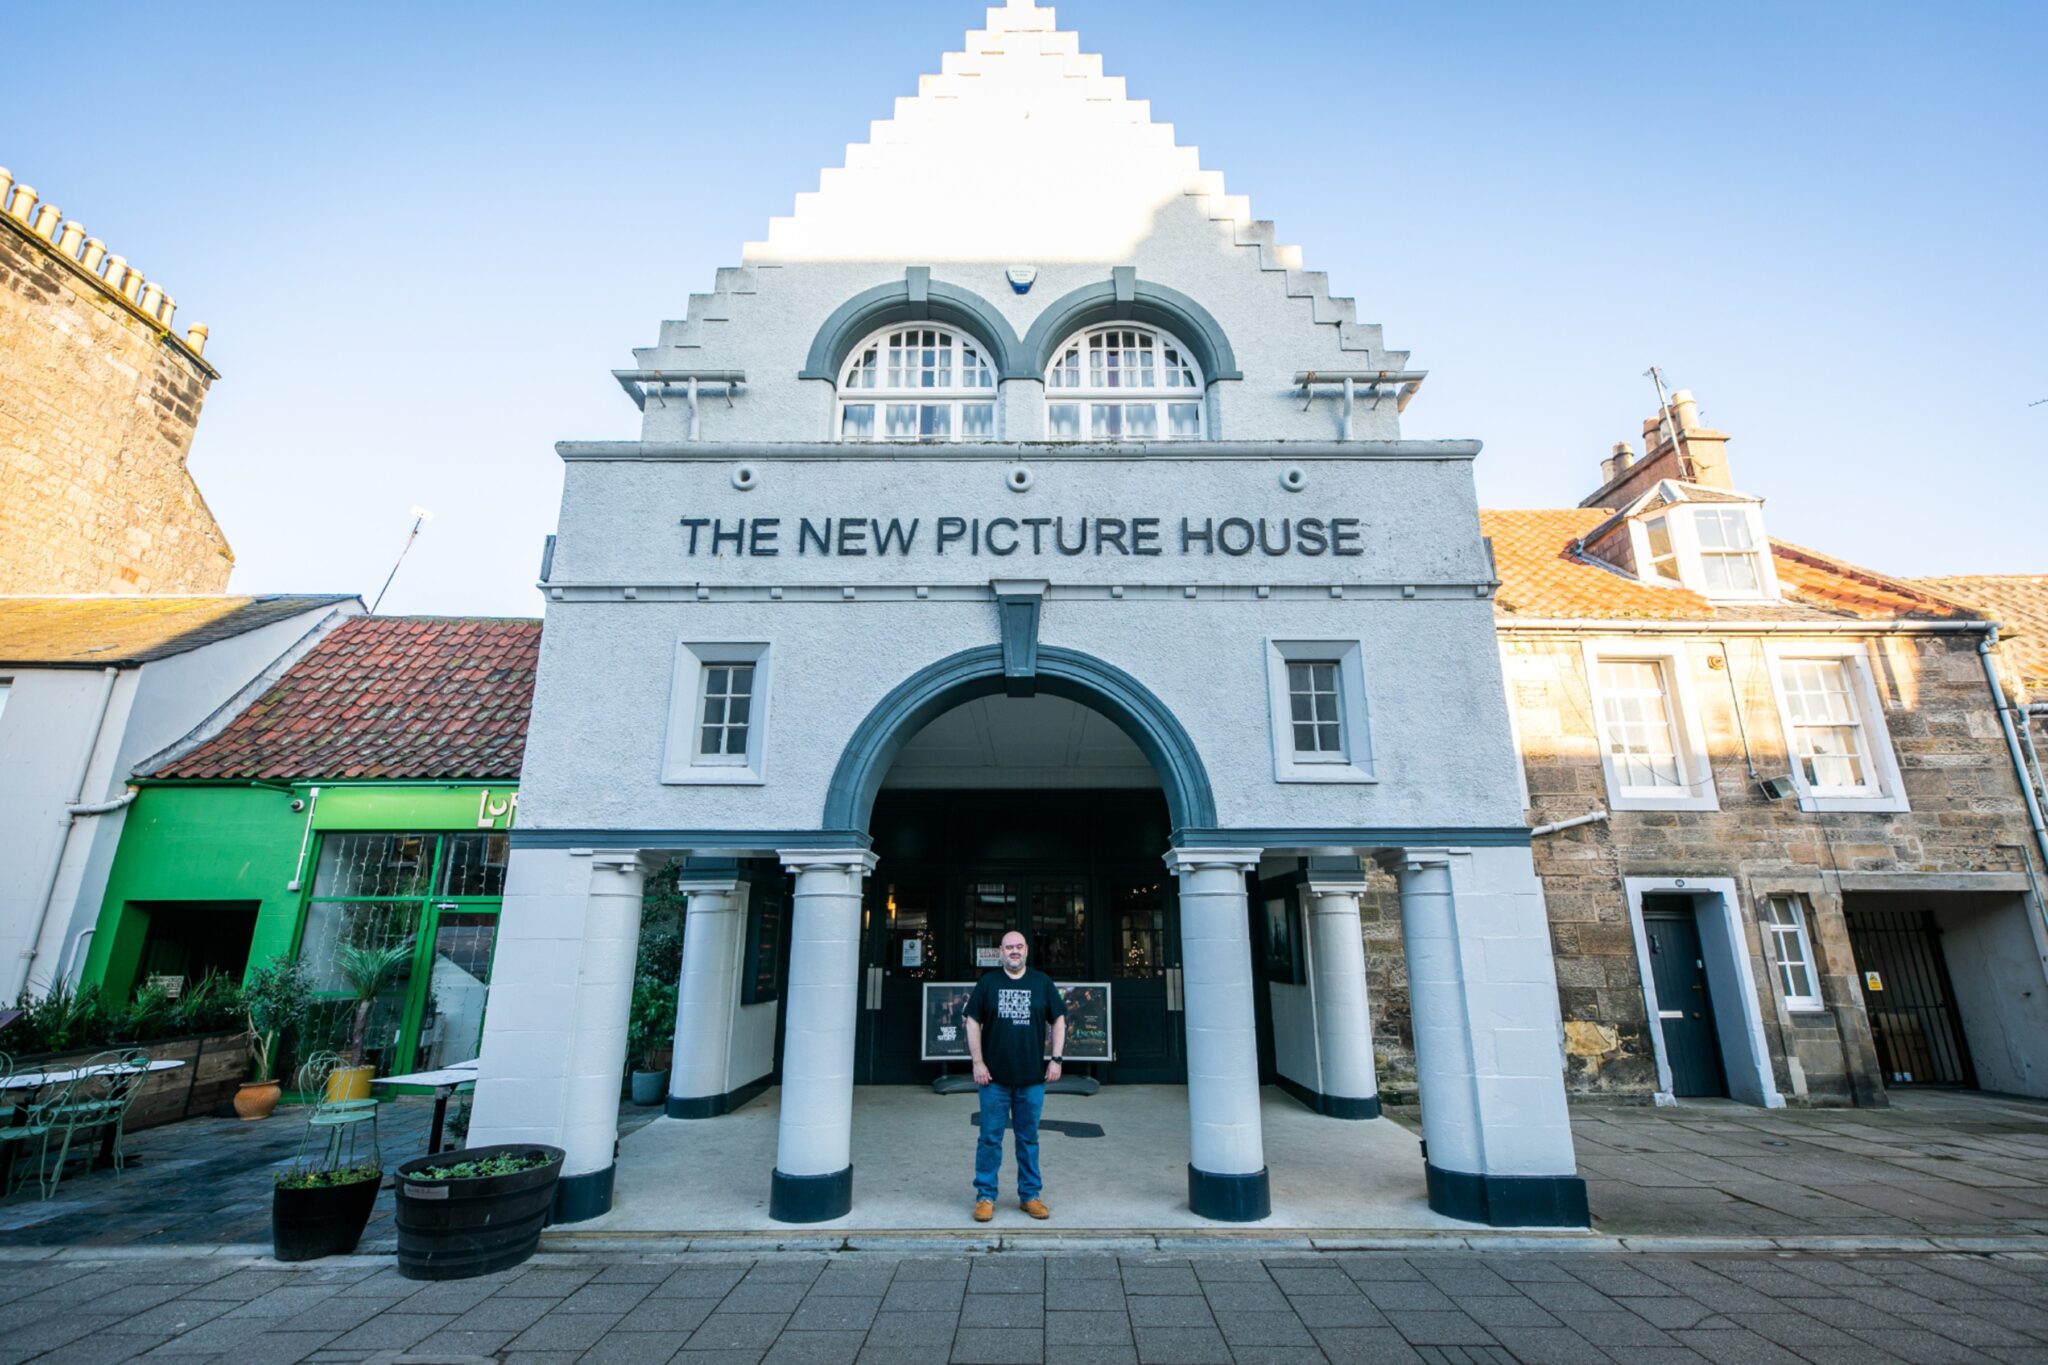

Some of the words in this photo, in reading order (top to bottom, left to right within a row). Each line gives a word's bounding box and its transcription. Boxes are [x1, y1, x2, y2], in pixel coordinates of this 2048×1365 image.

[680, 517, 780, 556] THE
[798, 517, 920, 556] NEW
[936, 516, 1162, 556] PICTURE
[1180, 517, 1364, 557] HOUSE
